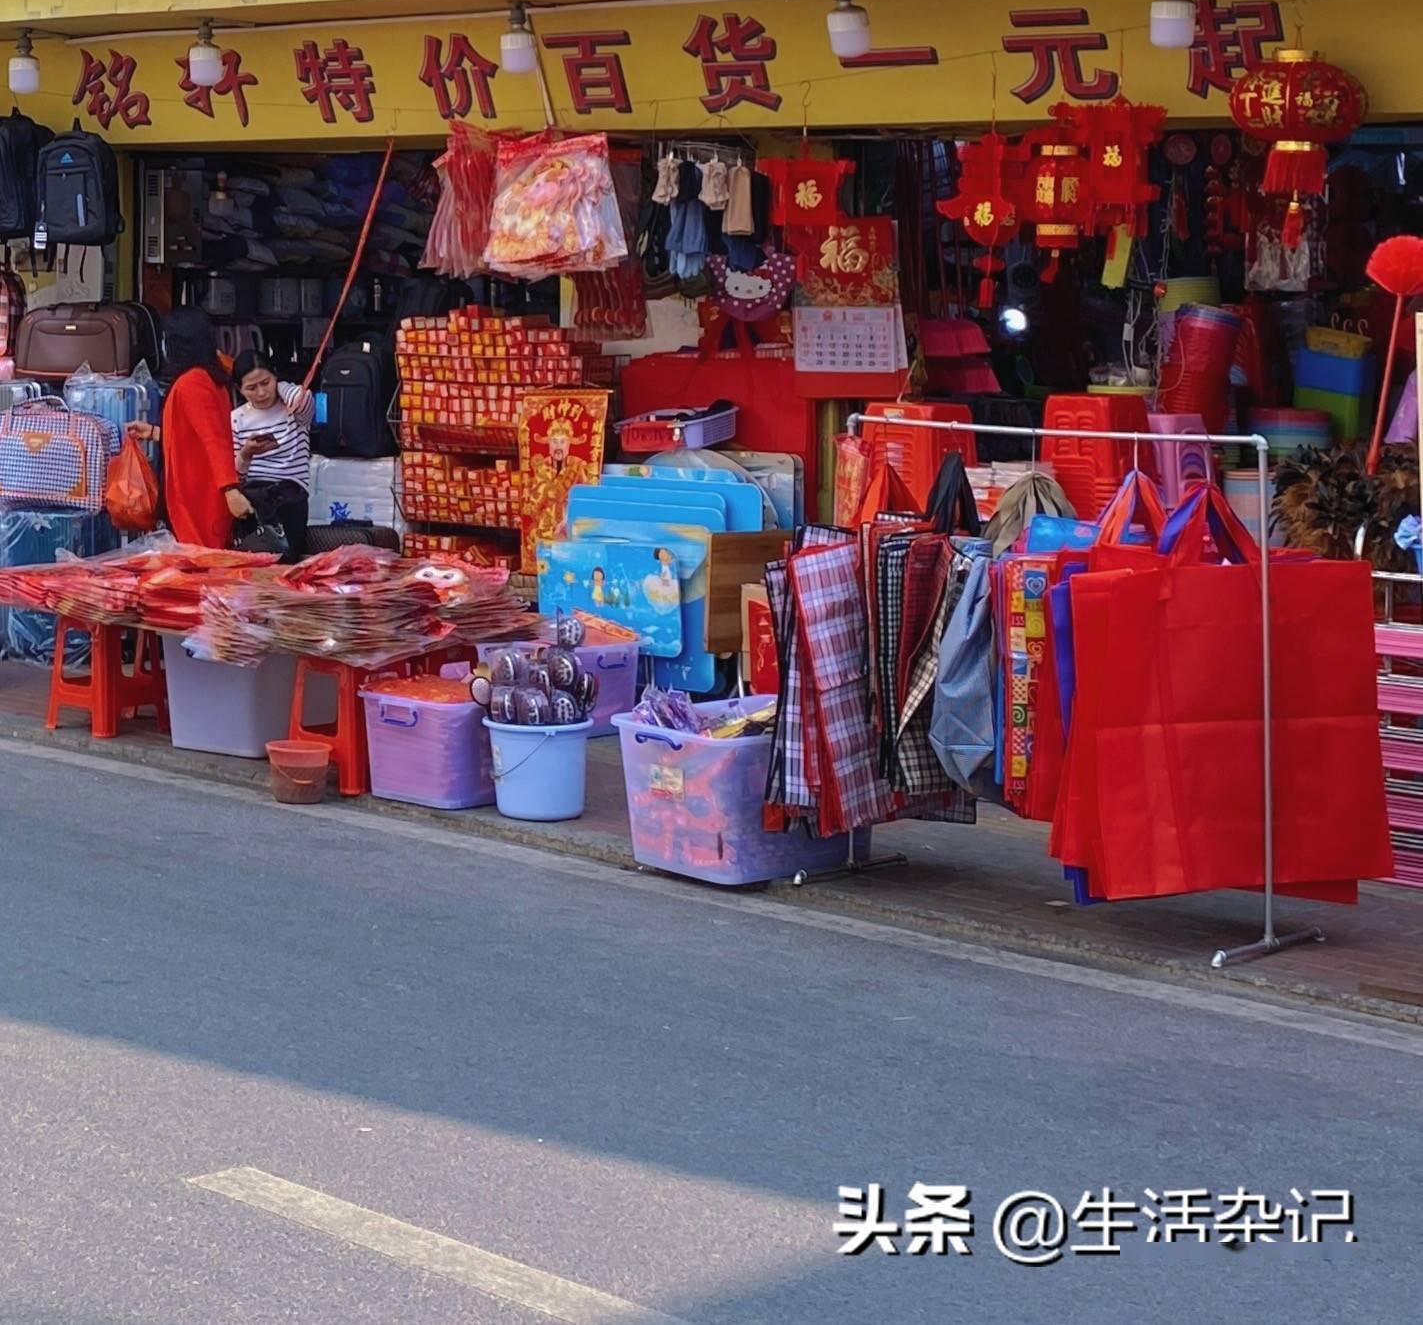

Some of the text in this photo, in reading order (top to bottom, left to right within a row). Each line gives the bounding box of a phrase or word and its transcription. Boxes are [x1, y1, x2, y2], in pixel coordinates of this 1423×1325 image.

[1295, 91, 1313, 108] 福
[1103, 145, 1122, 167] 福
[795, 179, 823, 210] 福
[974, 201, 995, 227] 福
[820, 226, 869, 274] 福
